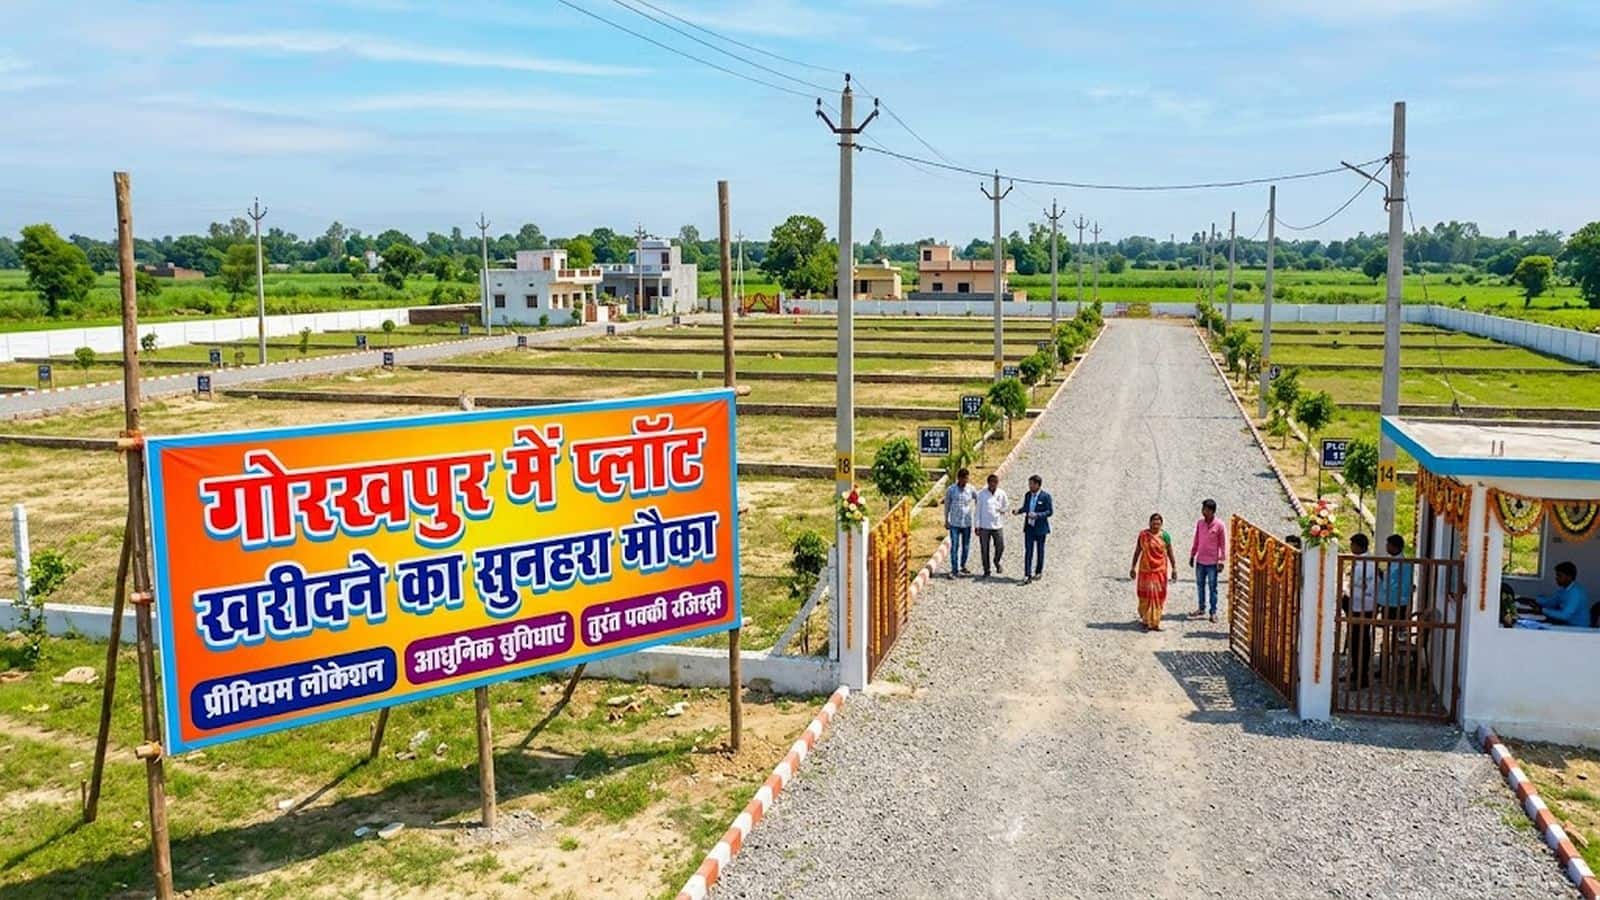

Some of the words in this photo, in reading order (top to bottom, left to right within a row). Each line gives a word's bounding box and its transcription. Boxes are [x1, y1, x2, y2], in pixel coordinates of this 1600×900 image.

[201, 451, 494, 542] गोरखपुर
[503, 425, 563, 504] में
[572, 415, 705, 496] प्लॉट
[838, 458, 850, 474] 18
[1380, 465, 1394, 482] 14
[196, 552, 387, 644] खरीदने
[397, 552, 467, 607] का
[474, 530, 614, 611] सुनहरा
[621, 508, 719, 569] मौका
[587, 607, 622, 642] तुरंत
[671, 586, 722, 618] रजिस्ट्री
[414, 636, 495, 675] आधुनिक
[498, 615, 567, 663] सुविधाएं
[203, 679, 295, 719] प्रीमियम
[299, 658, 385, 698] लोकेशन
